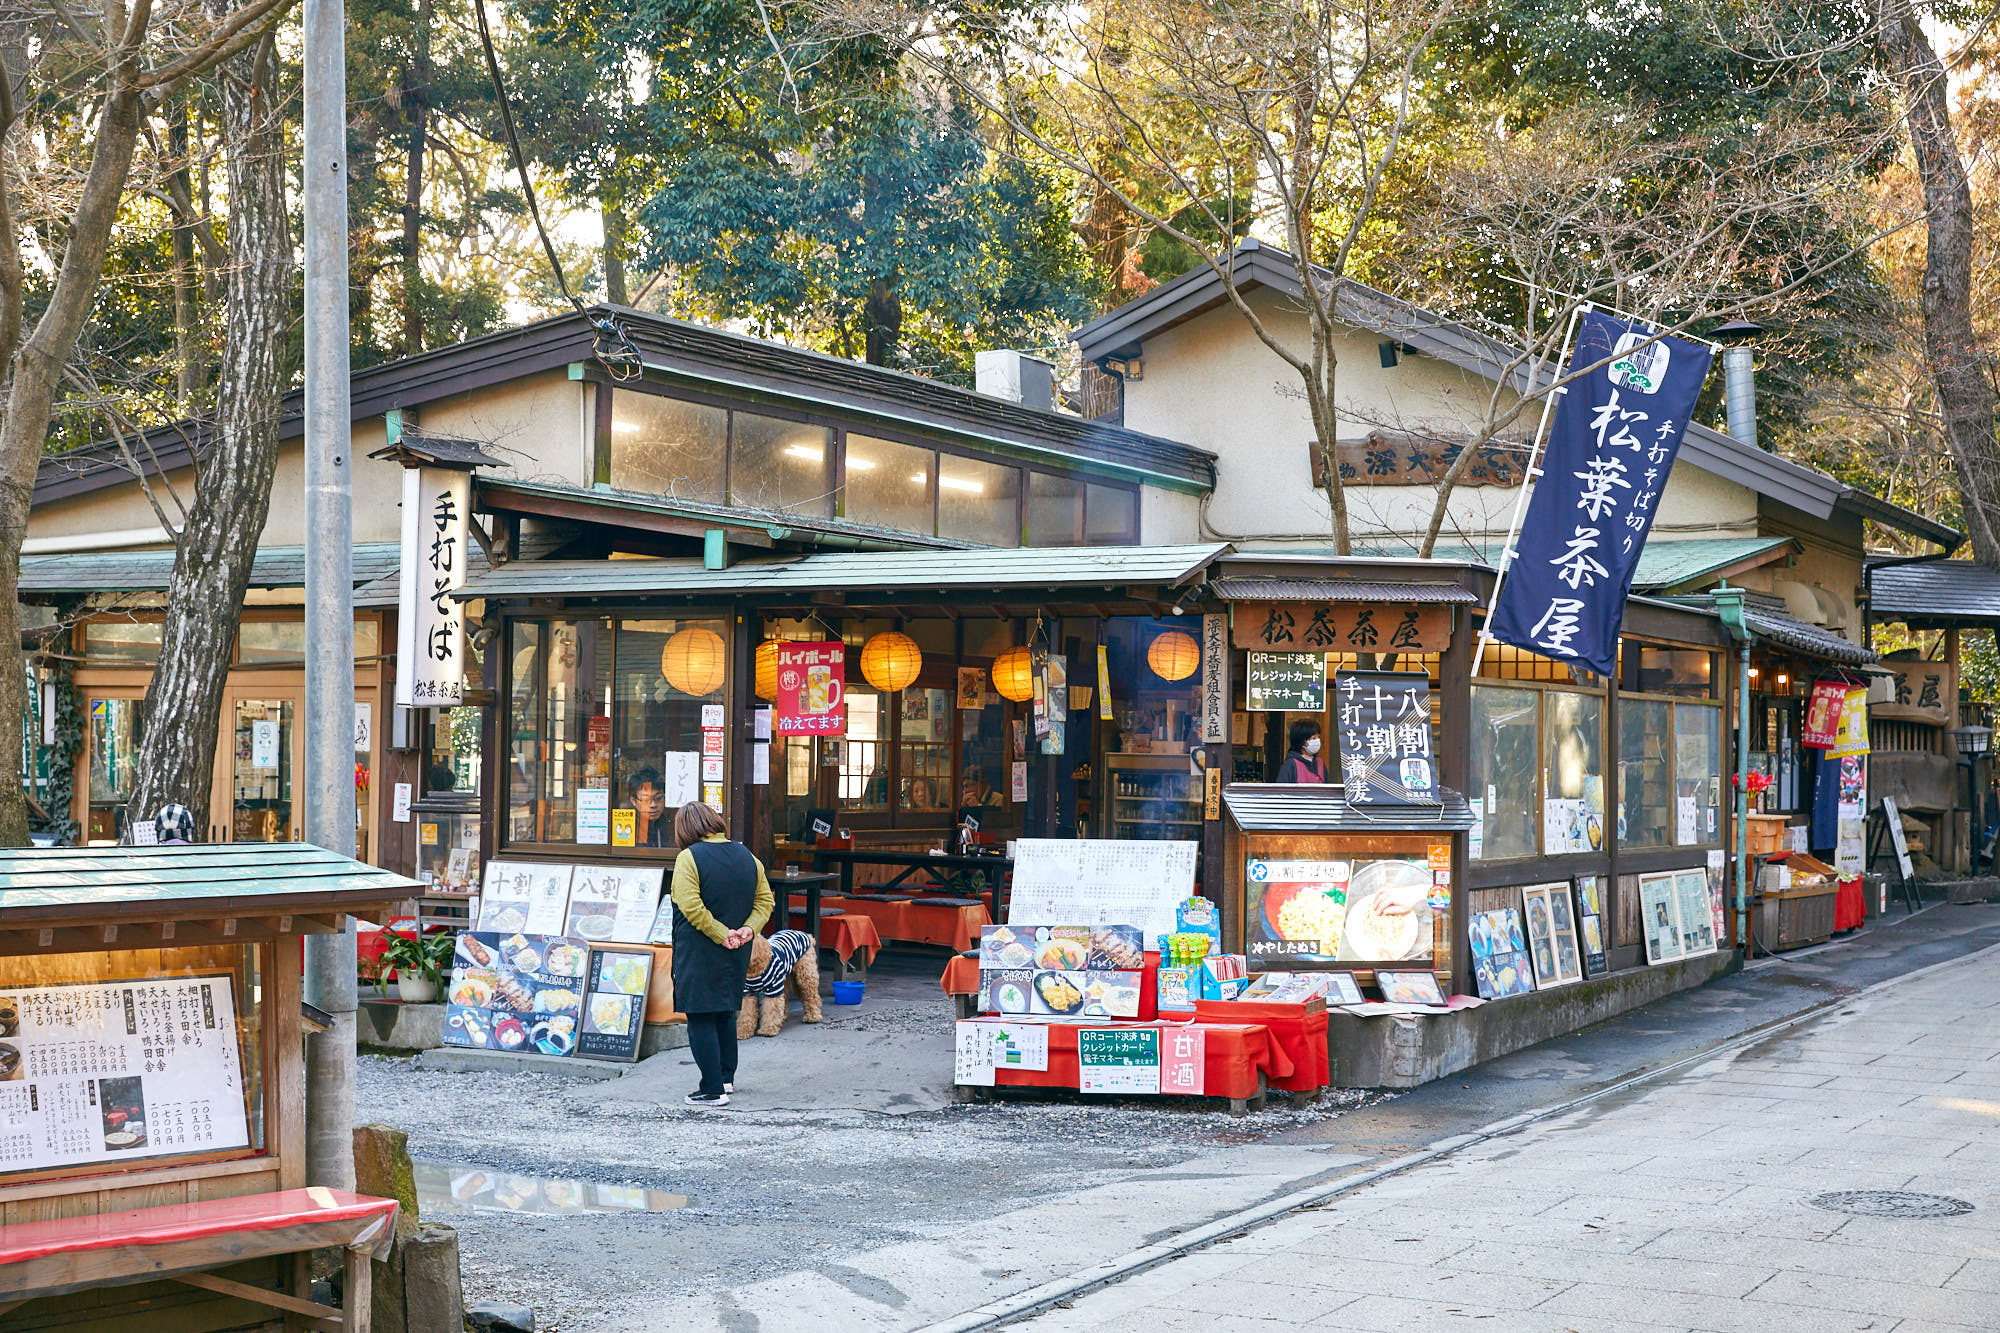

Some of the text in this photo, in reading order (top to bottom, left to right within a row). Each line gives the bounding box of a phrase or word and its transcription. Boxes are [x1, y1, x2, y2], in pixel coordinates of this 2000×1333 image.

[1623, 419, 1676, 554] 手打そば切り
[1530, 388, 1649, 658] 松葉茶屋
[428, 490, 459, 662] 手打そば
[779, 649, 844, 665] ハイボール
[1251, 652, 1316, 665] QRコード決済
[1251, 670, 1320, 682] クレジットカード
[414, 679, 461, 700] 松葉茶屋
[1251, 687, 1302, 700] 電子マネー
[1298, 701, 1321, 709] 使えます
[779, 715, 844, 731] 冷えてます
[1363, 684, 1397, 760] 十割
[1396, 687, 1431, 759] 八割
[1340, 676, 1374, 803] 手打ち蕎麦
[491, 871, 533, 897] 十割
[577, 876, 622, 901] 八割
[1251, 940, 1319, 954] 冷やしたぬき
[43, 993, 53, 1026] 天もり
[73, 992, 82, 1020] おろし
[84, 990, 93, 1021] とろろ
[113, 989, 120, 1009] もり
[160, 986, 175, 1057] 太打ち釜揚げ
[177, 986, 192, 1046] 太打ち田舎
[188, 984, 203, 1048] 細打ちせいろ
[1082, 1031, 1138, 1042] QRコード決済
[1082, 1043, 1145, 1053] クレジットカード
[1082, 1053, 1123, 1064] 電子マネー
[1173, 1034, 1195, 1087] 甘酒
